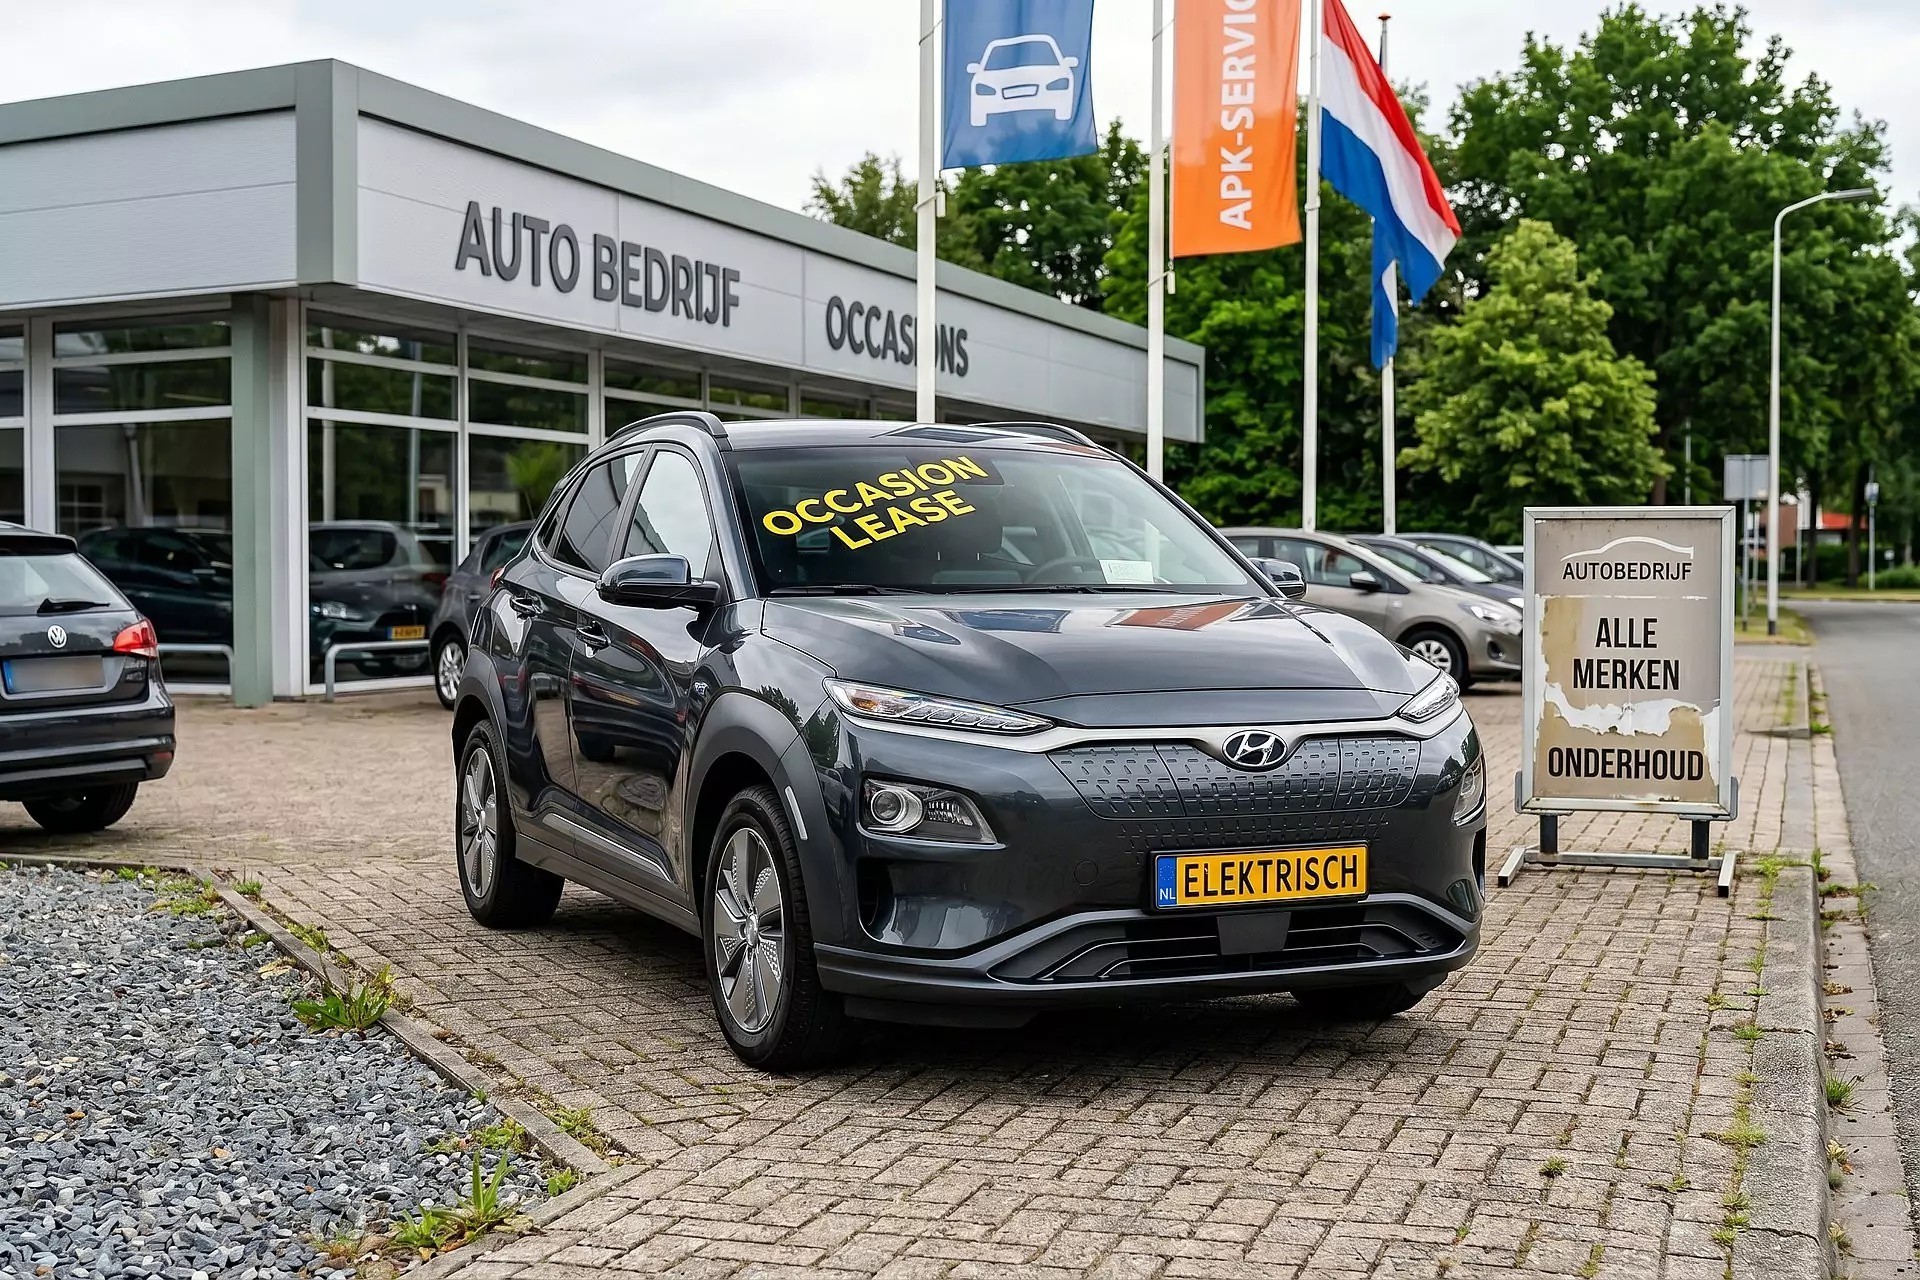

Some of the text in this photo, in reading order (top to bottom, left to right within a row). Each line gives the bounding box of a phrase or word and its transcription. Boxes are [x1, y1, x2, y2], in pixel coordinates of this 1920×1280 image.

[455, 200, 740, 327] AUTO BEDRIJF
[826, 295, 969, 377] OCCASNS
[762, 455, 989, 536] OCCASION
[829, 489, 976, 550] LEASE
[1562, 561, 1692, 581] AUTOBEDRIJF
[1595, 617, 1658, 648] ALLE
[1573, 658, 1680, 691] MERKEN
[1548, 747, 1704, 781] ONDERHOUD
[1159, 854, 1358, 900] NL ELEKTRISCH
